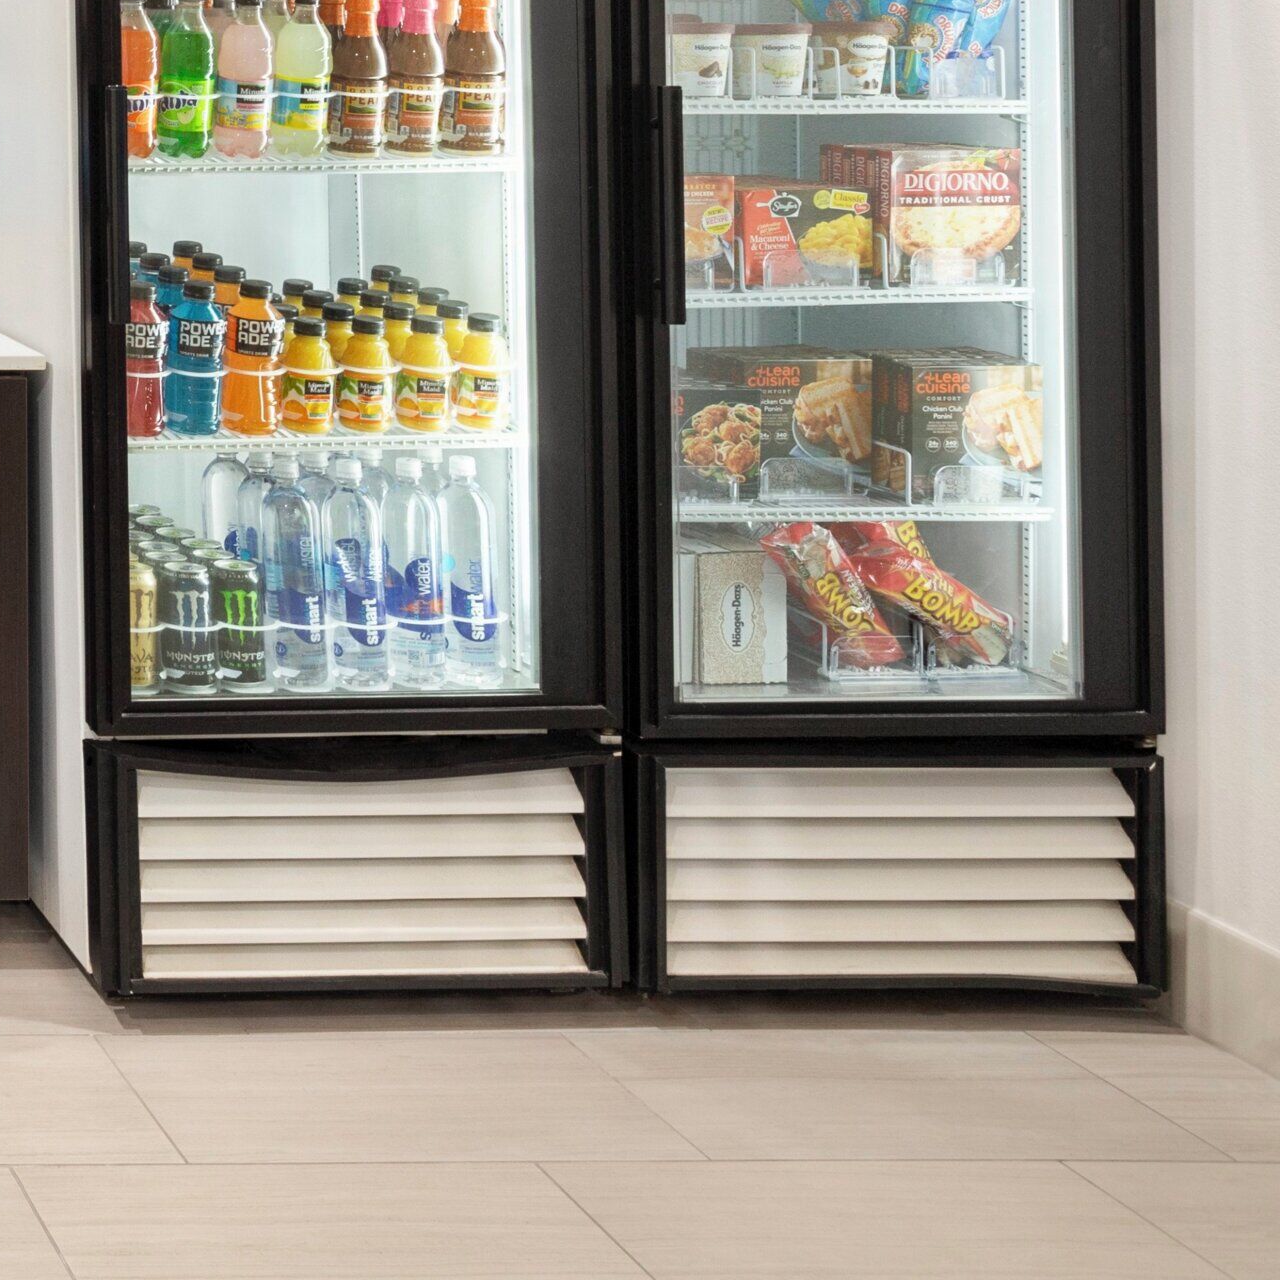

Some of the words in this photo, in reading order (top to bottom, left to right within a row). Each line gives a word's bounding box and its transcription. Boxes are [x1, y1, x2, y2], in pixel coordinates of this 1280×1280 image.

[900, 196, 972, 205] TRADITIONAL
[976, 195, 1011, 204] CRUST
[749, 234, 791, 244] Macaroni
[922, 405, 945, 413] Chicken
[310, 595, 320, 644] smart
[367, 597, 377, 646] smart
[473, 593, 485, 641] smart
[732, 584, 741, 648] Häagen-Dazs
[905, 573, 981, 633] BOMB
